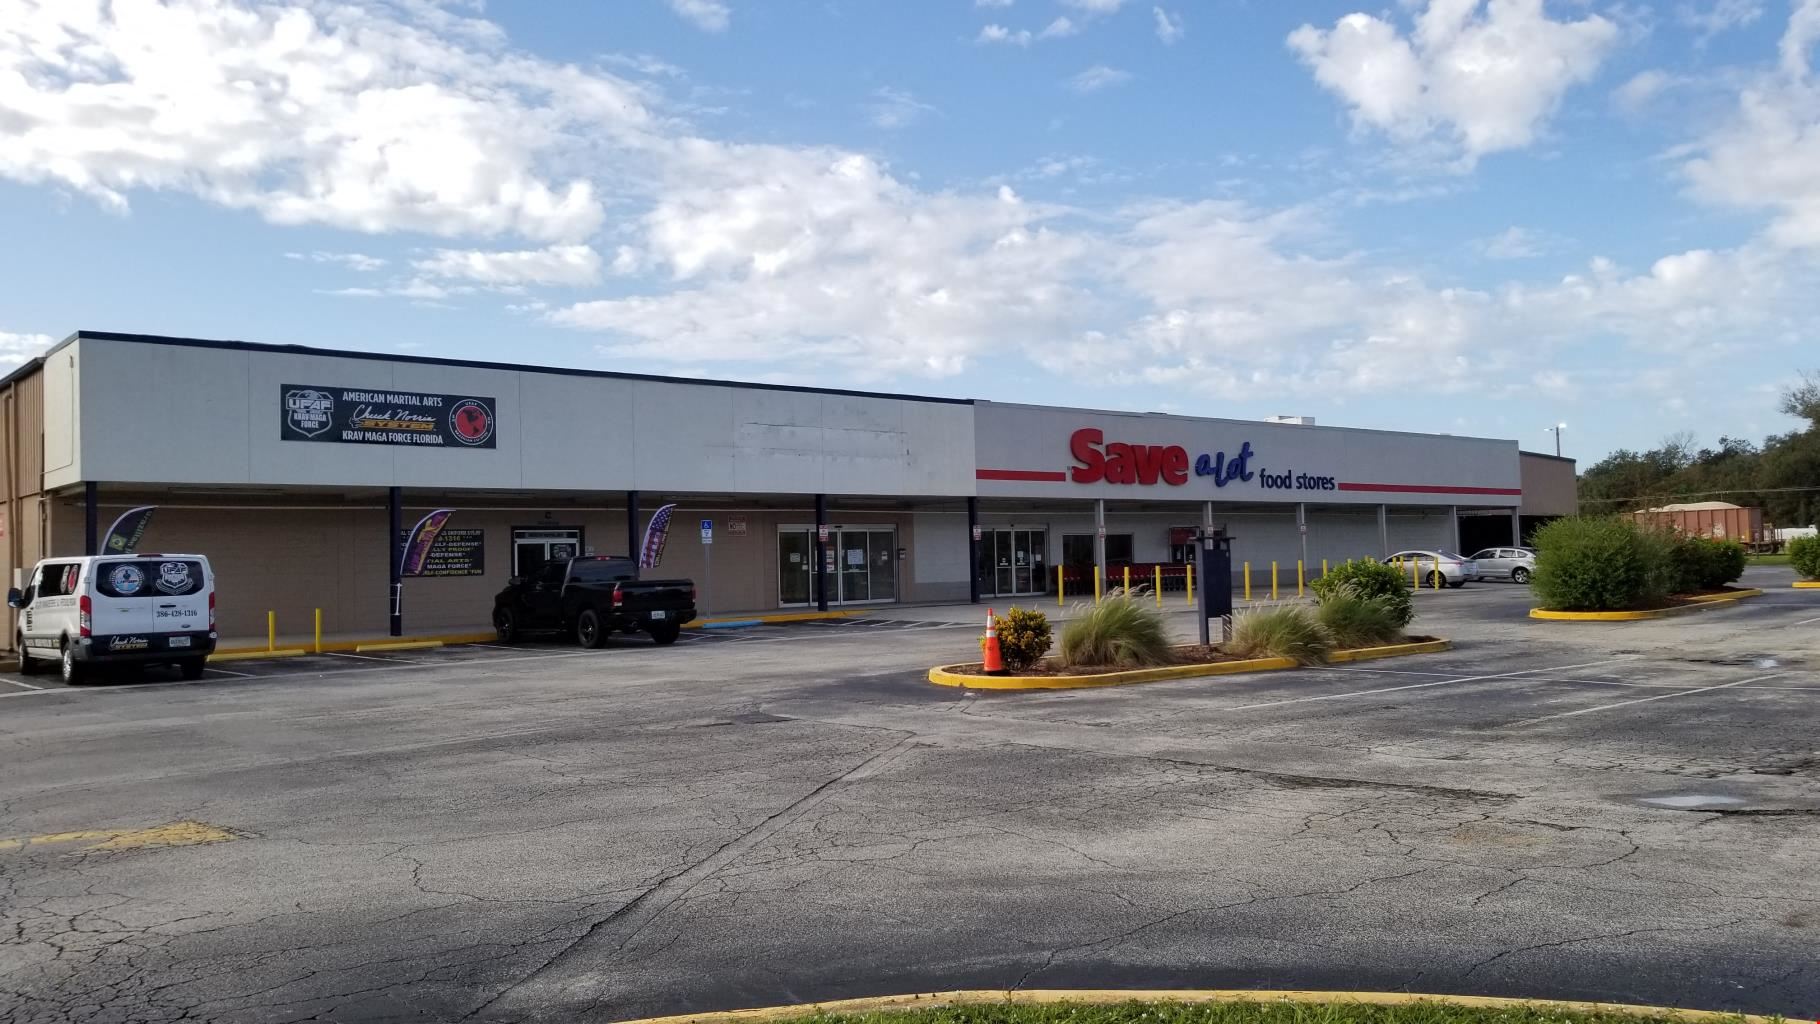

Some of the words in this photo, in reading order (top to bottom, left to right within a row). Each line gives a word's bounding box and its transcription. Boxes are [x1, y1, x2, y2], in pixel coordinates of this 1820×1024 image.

[342, 391, 385, 404] AMERICAN
[387, 394, 421, 406] MARTIAL
[423, 396, 442, 407] ARTS
[294, 412, 310, 421] KRAV
[310, 413, 327, 422] MAGA
[353, 404, 392, 420] Chuck
[395, 409, 436, 421] Norris
[301, 420, 319, 429] FORCE
[342, 430, 363, 441] KRAV
[365, 432, 387, 443] MAGA
[388, 432, 411, 443] FORCE
[413, 434, 443, 445] FLORIDA
[1070, 428, 1189, 485] Save
[1259, 468, 1292, 489] food
[1295, 474, 1335, 491] stores
